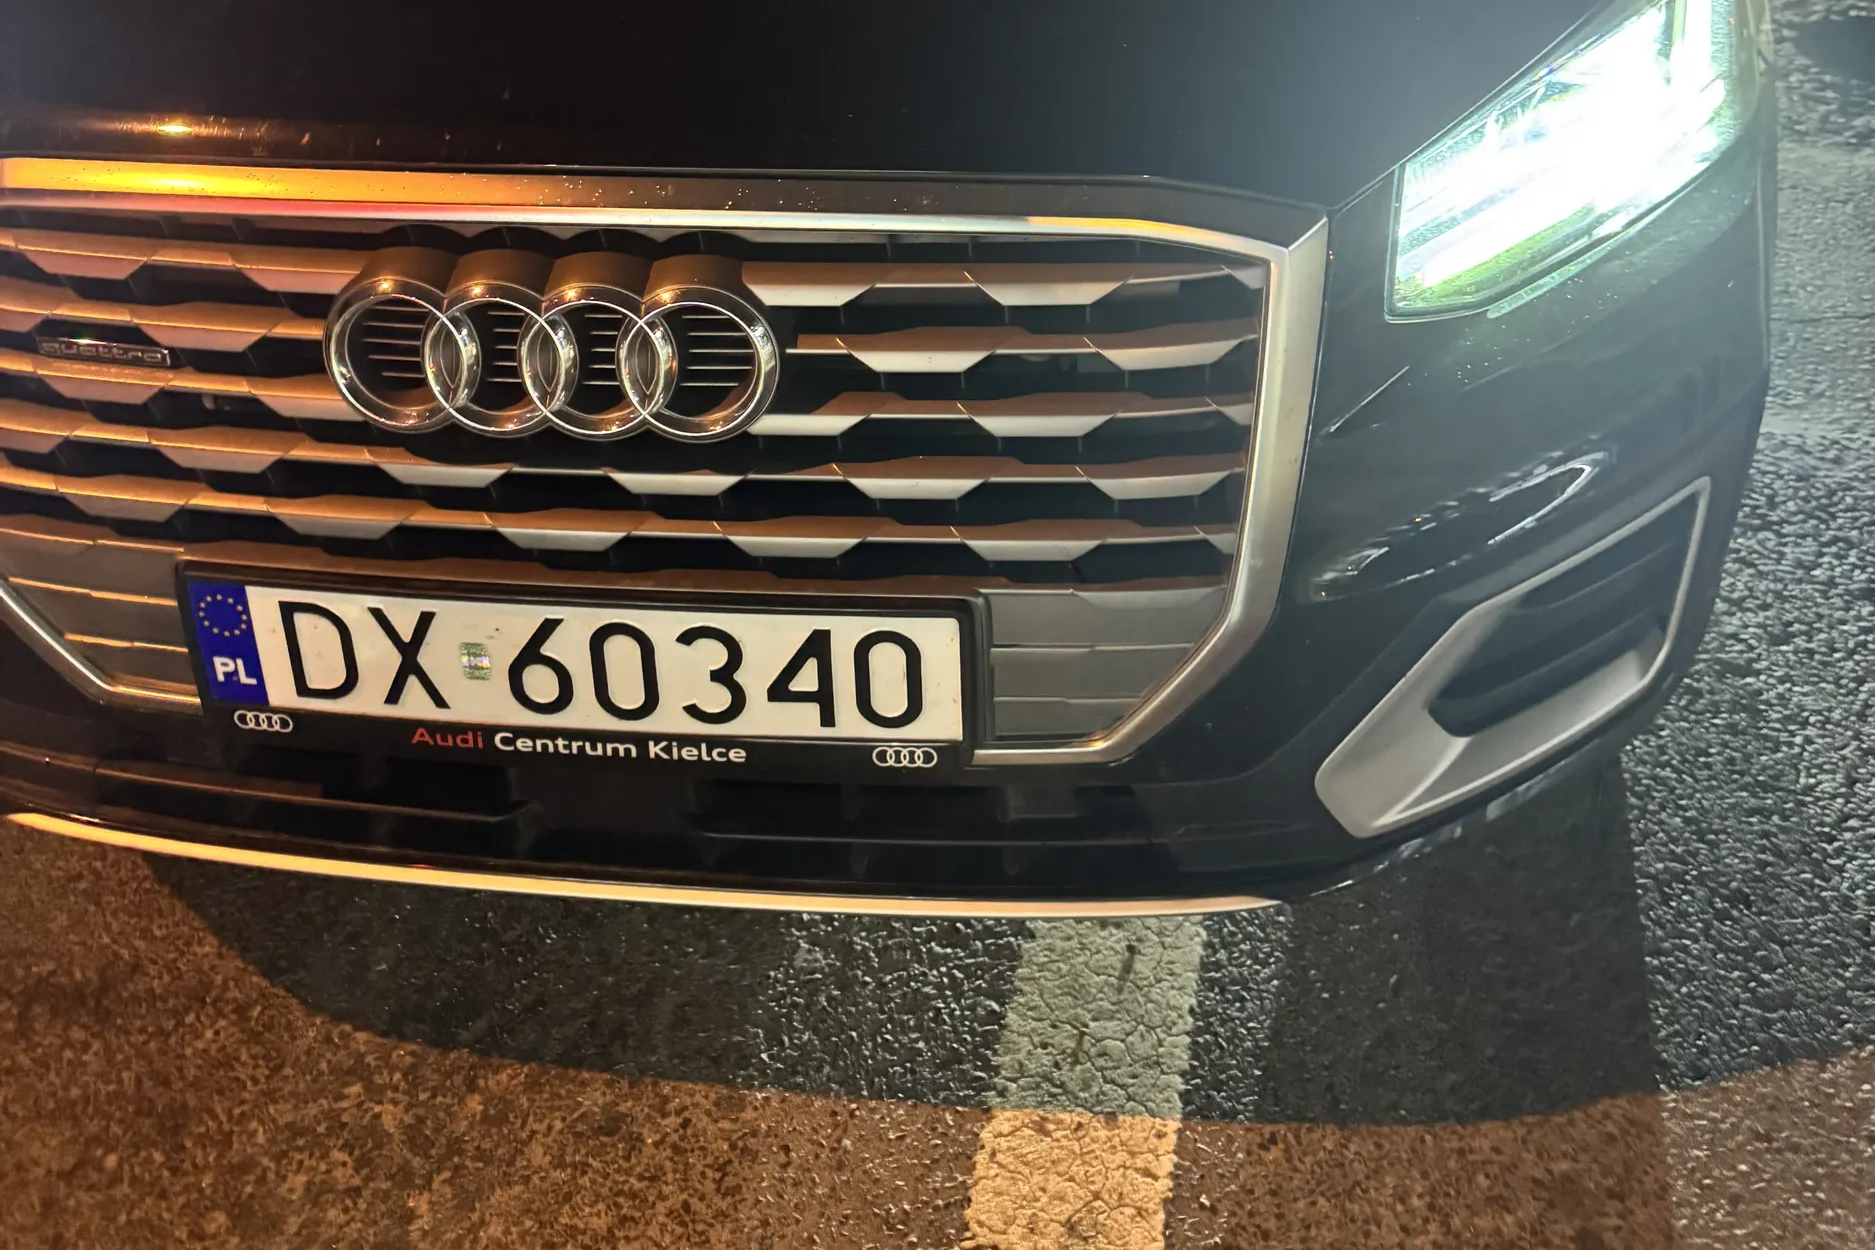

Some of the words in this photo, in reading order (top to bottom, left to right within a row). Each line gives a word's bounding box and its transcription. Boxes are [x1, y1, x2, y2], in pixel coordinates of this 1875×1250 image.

[42, 340, 162, 363] quattro
[212, 655, 258, 685] PL
[277, 600, 451, 709] DX
[507, 617, 924, 729] 60340
[411, 727, 484, 749] Audi
[494, 732, 638, 758] Centrum
[648, 740, 747, 763] Kielce
